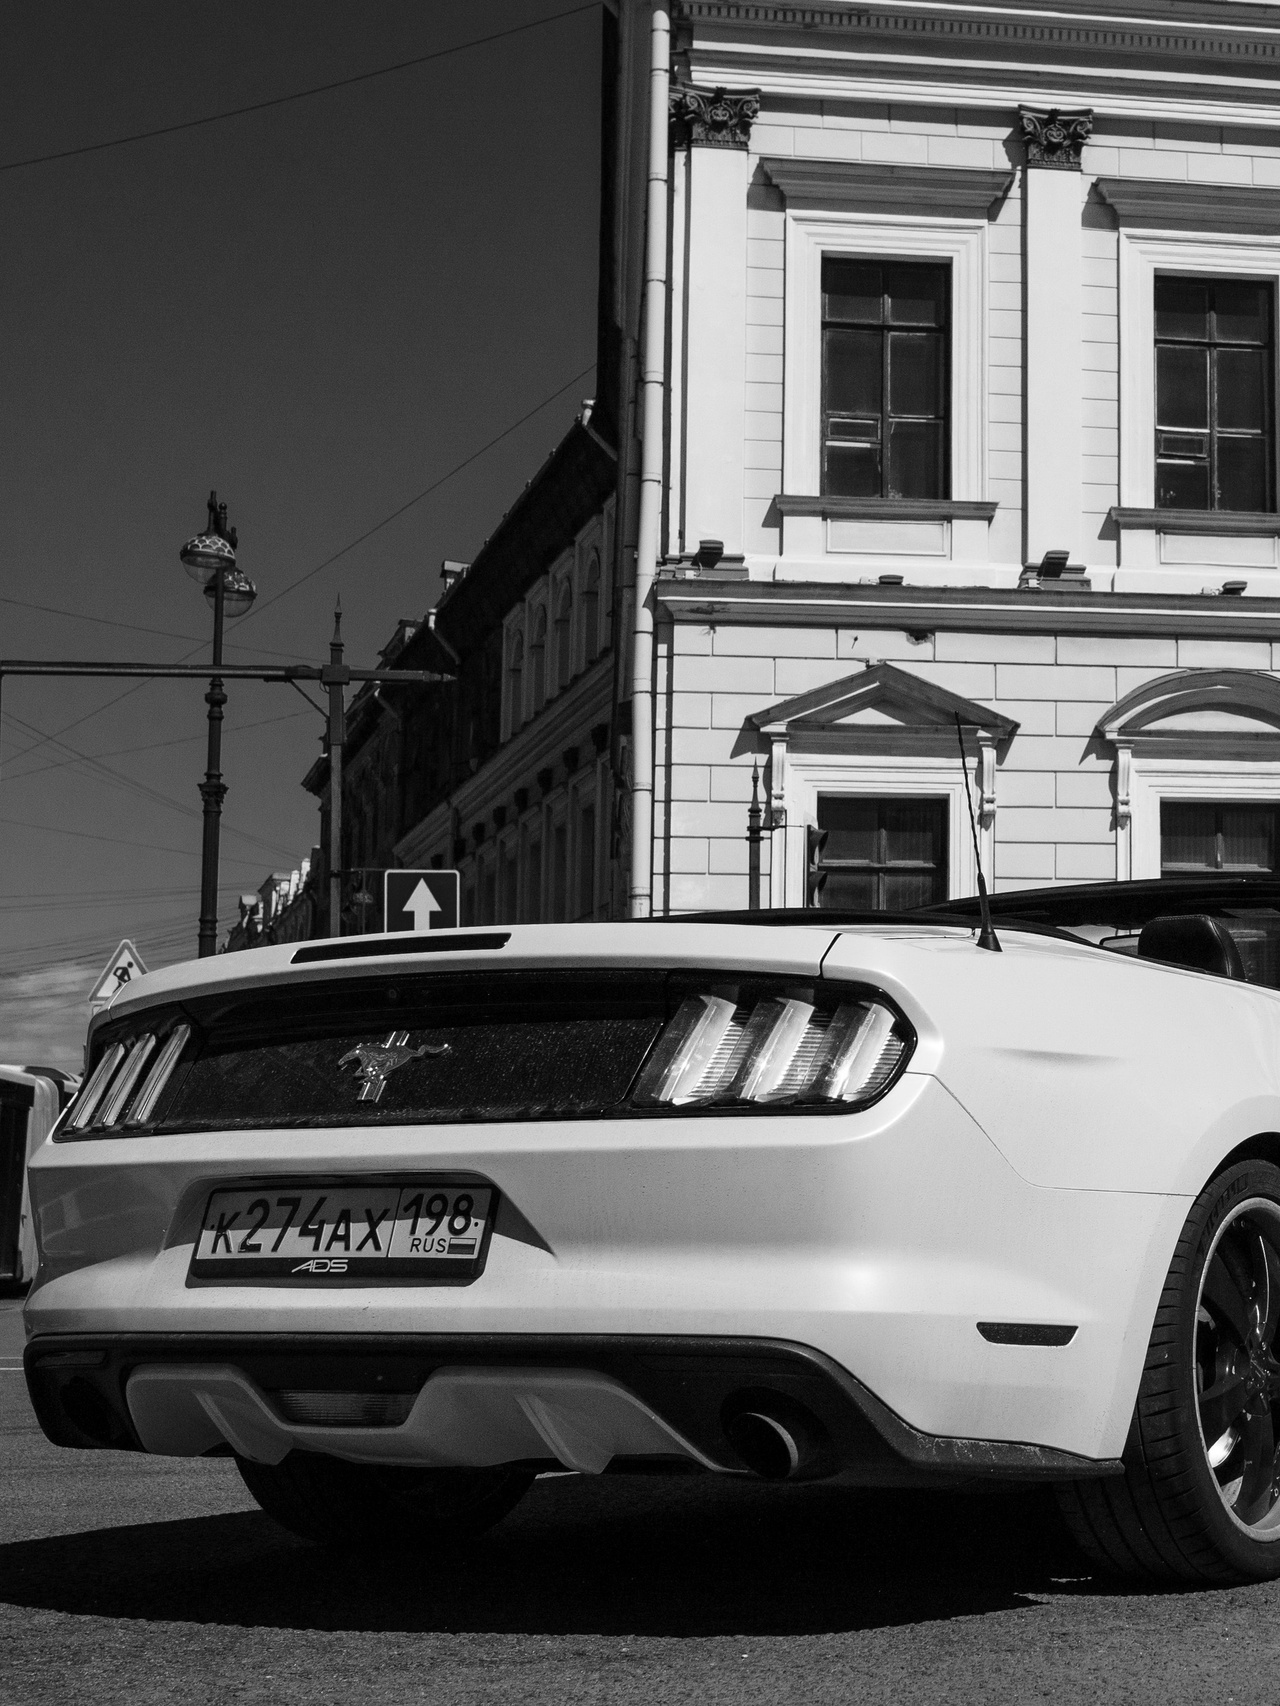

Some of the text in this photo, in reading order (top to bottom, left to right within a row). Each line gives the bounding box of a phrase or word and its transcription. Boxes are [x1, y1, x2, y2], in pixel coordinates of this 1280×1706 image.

[210, 1193, 475, 1254] K274AX 198
[410, 1237, 447, 1253] RUS
[291, 1258, 349, 1273] ADS
